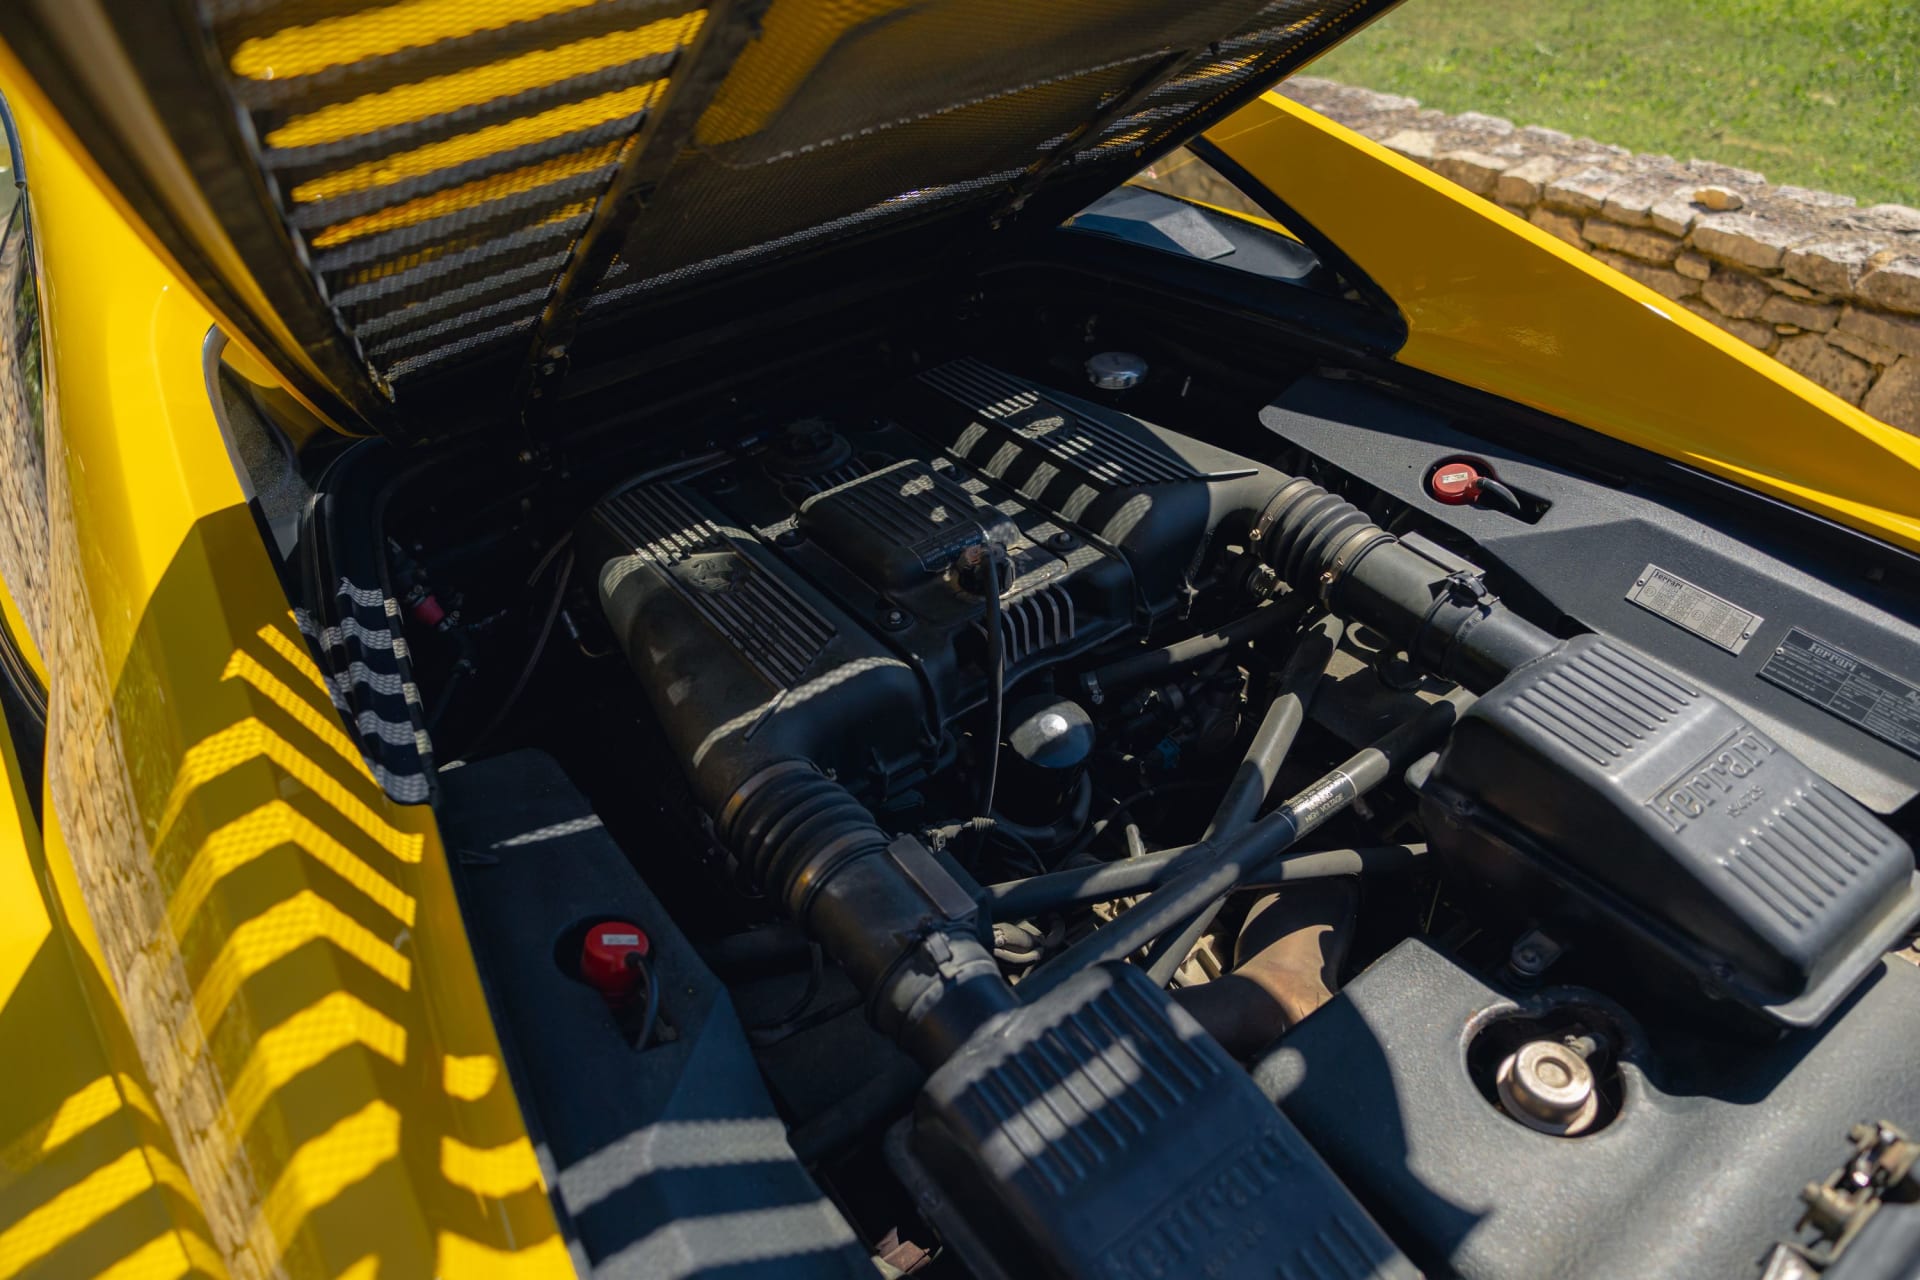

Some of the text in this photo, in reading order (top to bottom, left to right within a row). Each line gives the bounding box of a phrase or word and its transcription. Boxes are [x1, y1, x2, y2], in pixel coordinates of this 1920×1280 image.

[1653, 570, 1684, 590] Ferrari
[1808, 642, 1858, 672] Ferrari
[1645, 724, 1777, 834] Ferrari
